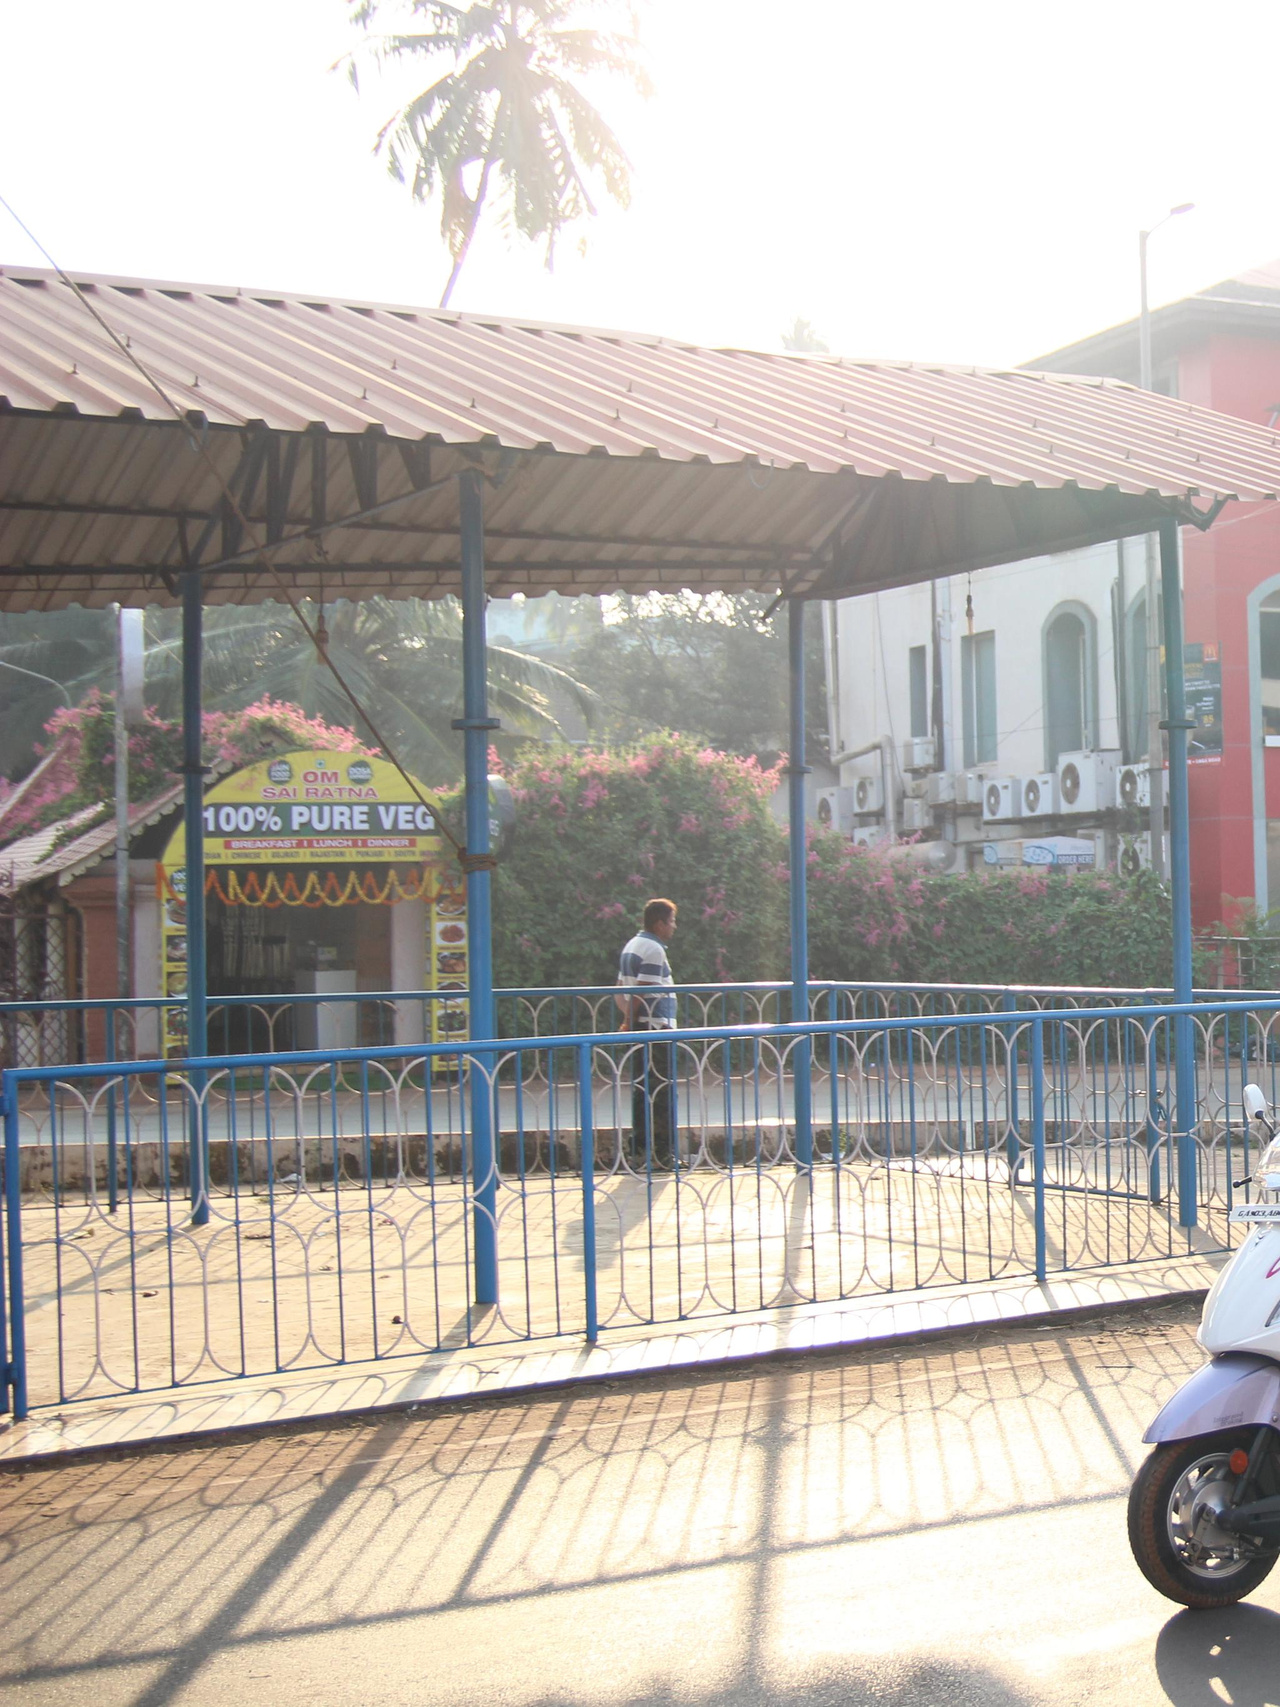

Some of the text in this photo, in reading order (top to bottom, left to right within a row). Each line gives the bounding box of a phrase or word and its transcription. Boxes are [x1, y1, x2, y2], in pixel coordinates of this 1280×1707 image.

[302, 770, 340, 785] OM
[262, 786, 379, 800] SAI RATNA
[203, 804, 436, 832] 100% PURE VEG
[231, 838, 410, 849] BREAKFAST LUNCH DINNER
[1058, 854, 1095, 864] ORDER HERE
